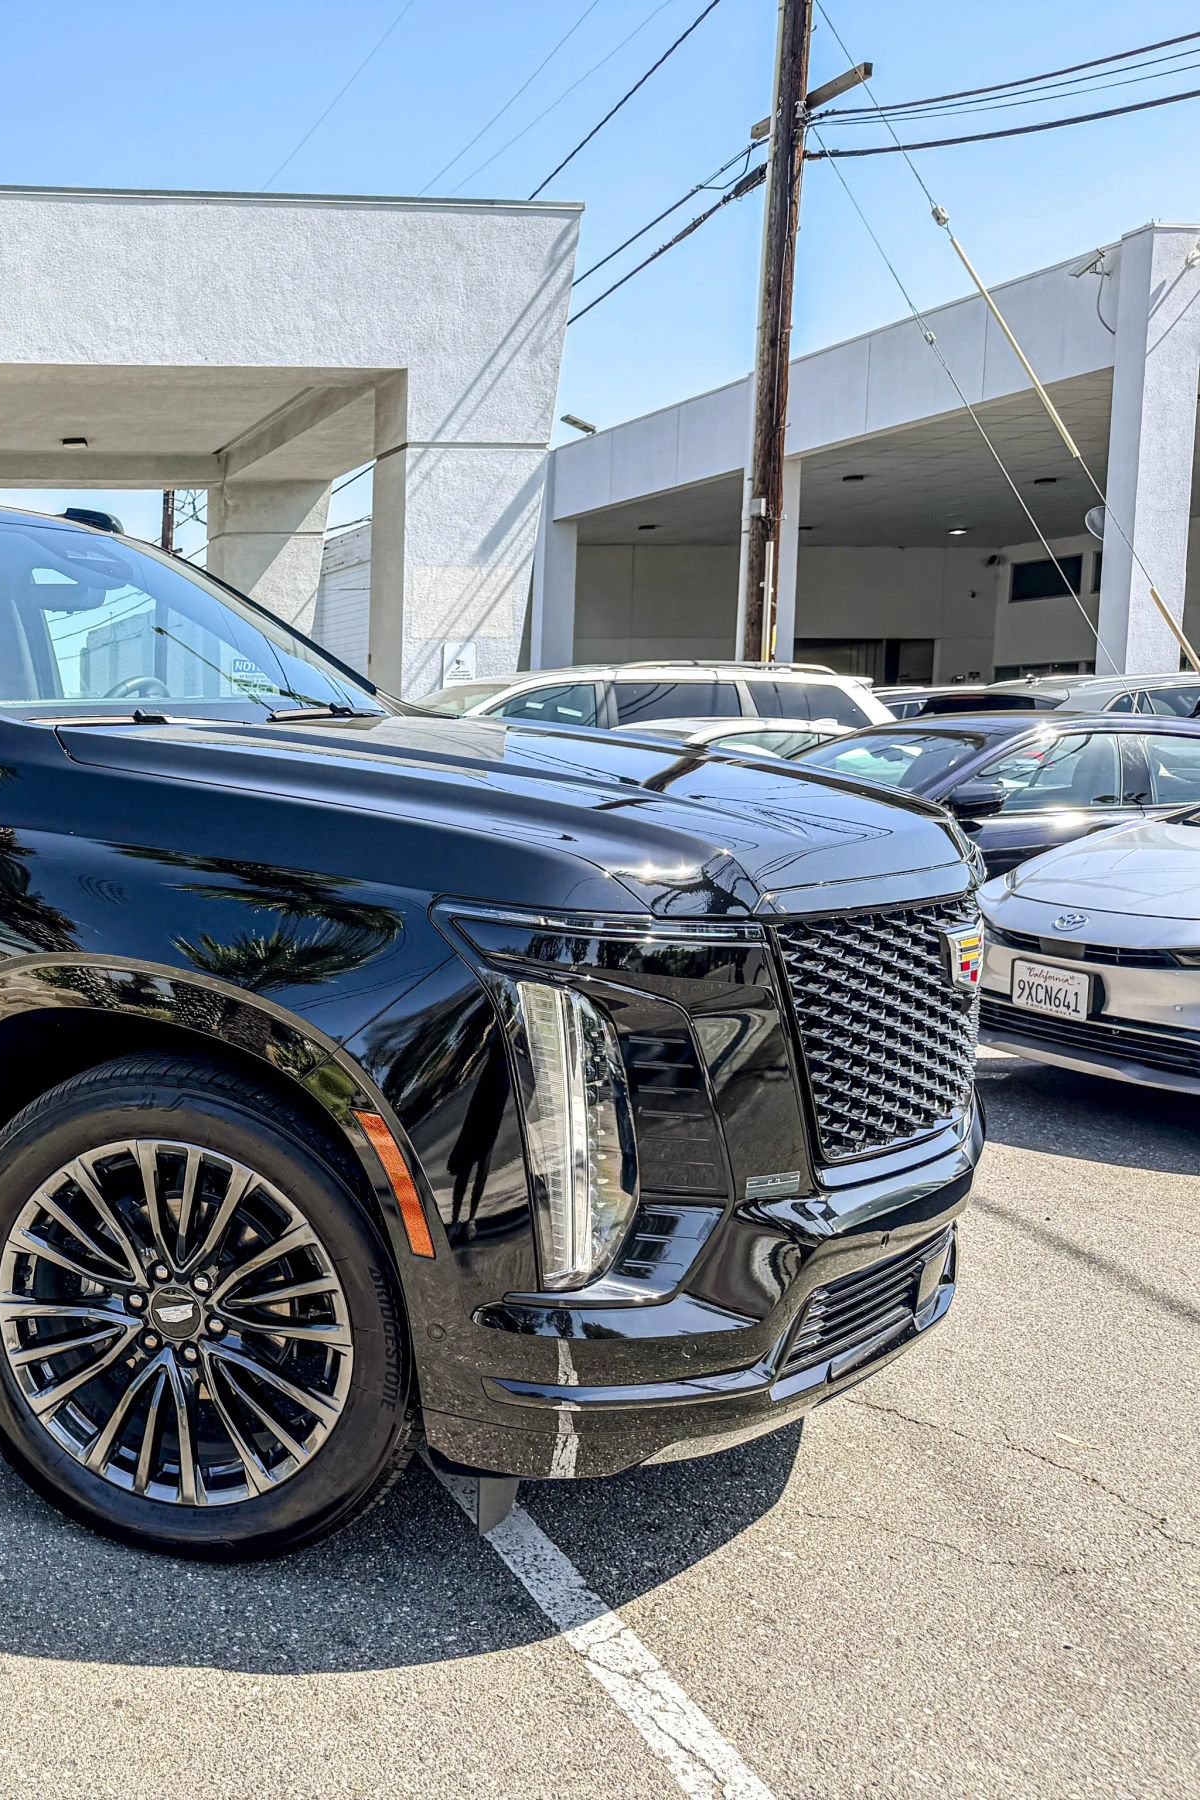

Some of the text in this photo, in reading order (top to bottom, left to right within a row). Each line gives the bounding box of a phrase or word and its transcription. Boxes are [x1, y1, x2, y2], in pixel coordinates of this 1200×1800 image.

[1028, 966, 1074, 985] California
[1017, 979, 1080, 1013] 9XCN641
[368, 1266, 403, 1412] BRIDGESTONE
